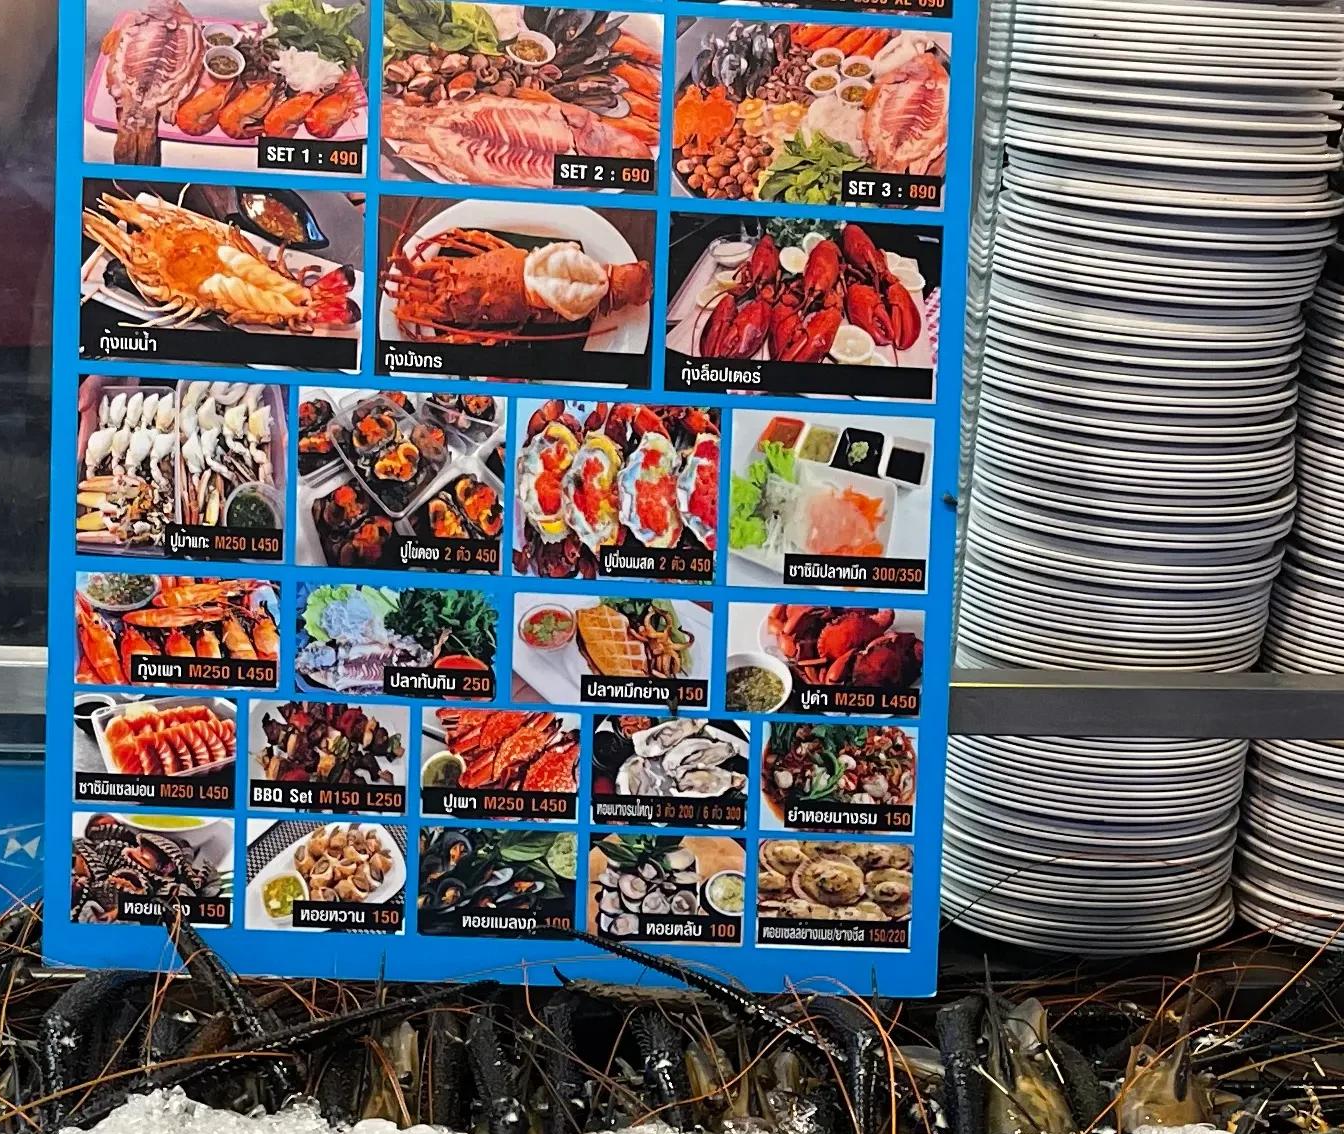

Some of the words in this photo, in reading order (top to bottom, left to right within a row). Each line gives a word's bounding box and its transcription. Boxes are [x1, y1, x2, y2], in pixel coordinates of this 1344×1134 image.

[266, 145, 296, 163] SET
[301, 148, 310, 164] 1
[329, 150, 358, 166] 490
[560, 163, 588, 180] SET
[593, 165, 604, 181] 2
[622, 167, 650, 183] 690
[848, 180, 876, 196] SET
[881, 182, 891, 197] 3
[909, 184, 937, 200] 890
[99, 329, 157, 354] กุ้งแม่น้ำ
[384, 346, 443, 371] กุ้งมังกร
[214, 535, 246, 551] M250
[251, 537, 279, 552] L450
[444, 546, 452, 561] 2
[475, 548, 497, 563] 450
[659, 556, 667, 571] 2
[689, 558, 711, 573] 450
[872, 566, 923, 583] 300/350
[137, 656, 182, 681] กุ้งเผา
[188, 664, 230, 680] M250
[237, 666, 274, 681] L450
[390, 672, 456, 690] ปลาทับทิม
[462, 676, 490, 692] 250
[587, 680, 670, 700] ปลาหมึกย่าง
[677, 686, 704, 701] 150
[801, 689, 828, 709] ปูดำ
[835, 692, 875, 707] M250
[881, 694, 917, 709] L450
[160, 783, 194, 799] M250
[199, 785, 229, 800] L450
[253, 787, 283, 803] BBQ
[289, 788, 313, 804] Set
[319, 789, 360, 806] M150
[366, 791, 402, 807] L250
[443, 793, 477, 813] ปูเผา
[484, 796, 525, 811] M250
[531, 798, 567, 813] L450
[787, 806, 878, 825] ยำหอยนางรม
[885, 812, 911, 826] 150
[199, 903, 225, 918] 150
[300, 909, 365, 923] หอยหวาน
[372, 910, 399, 925] 150
[646, 920, 703, 937] หอยตลับ
[710, 923, 736, 938] 100
[869, 928, 906, 943] 150/220
